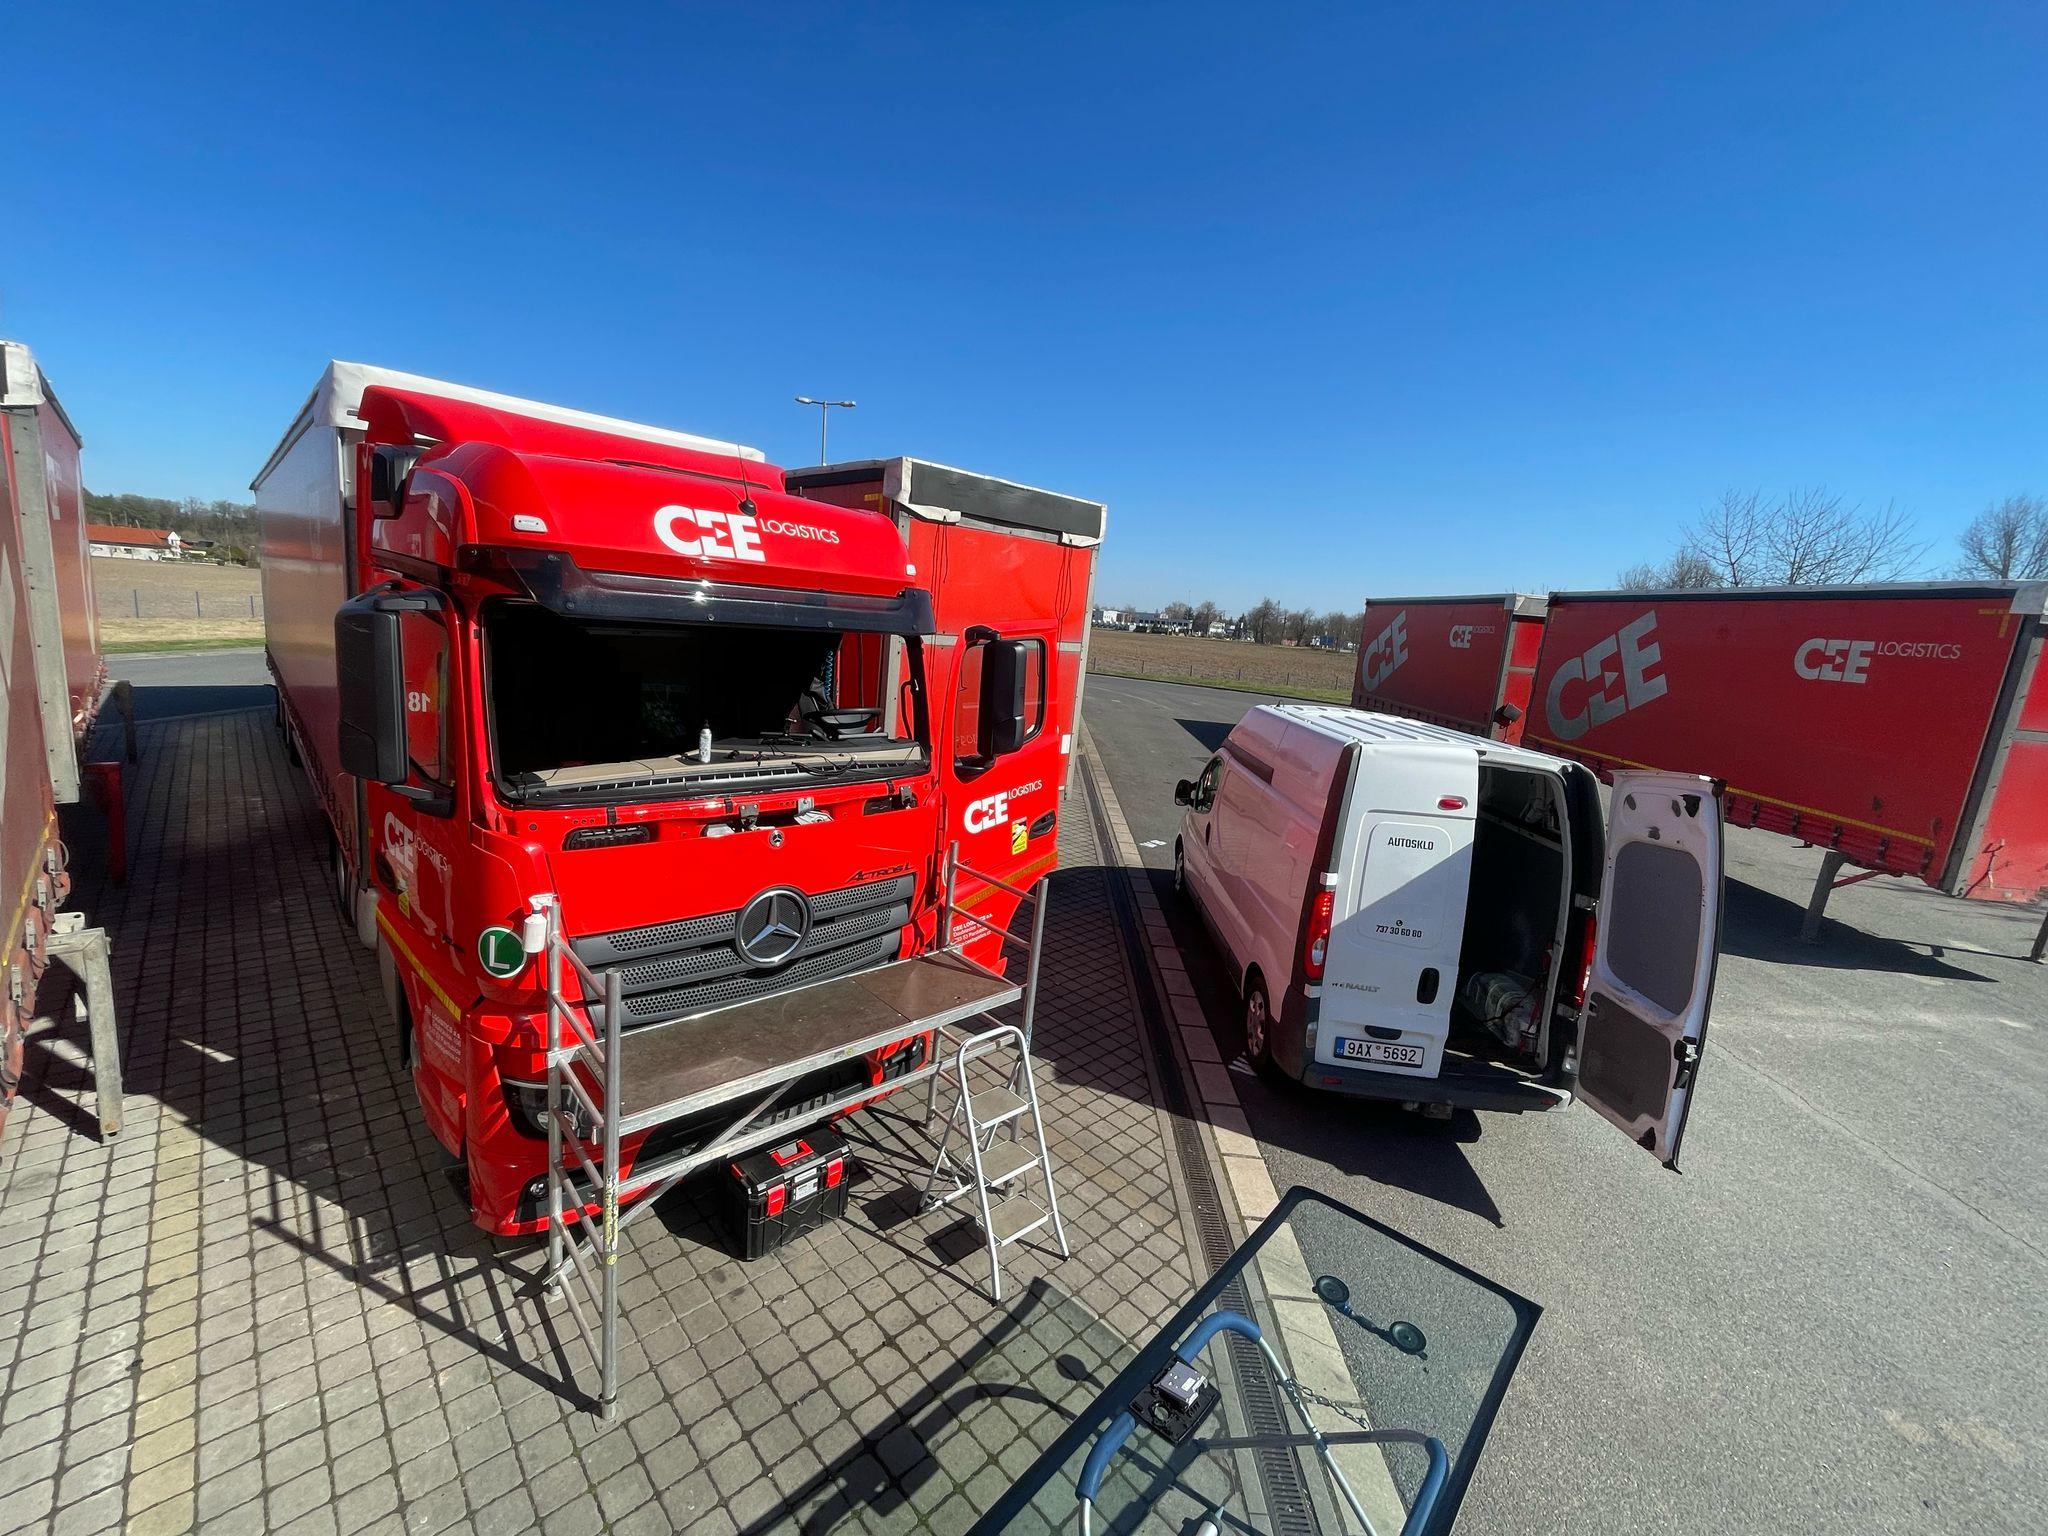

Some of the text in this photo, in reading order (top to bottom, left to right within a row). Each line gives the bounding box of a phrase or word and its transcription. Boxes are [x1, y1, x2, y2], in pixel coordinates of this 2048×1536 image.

[654, 505, 840, 562] CEE LOGISTICS
[1362, 609, 1409, 692] CEE
[1450, 624, 1473, 648] CEE
[1546, 609, 1668, 741] CEE
[1794, 637, 1962, 684] CEE LOGISTICS
[964, 780, 1043, 834] CEE LOGISTICS
[384, 811, 414, 874] CEE
[1387, 836, 1434, 851] AUTOSKLO
[489, 935, 510, 969] L
[1376, 925, 1388, 934] 737
[1390, 926, 1400, 935] 30
[1347, 1042, 1373, 1058] 9AX
[1383, 1046, 1417, 1063] 5692
